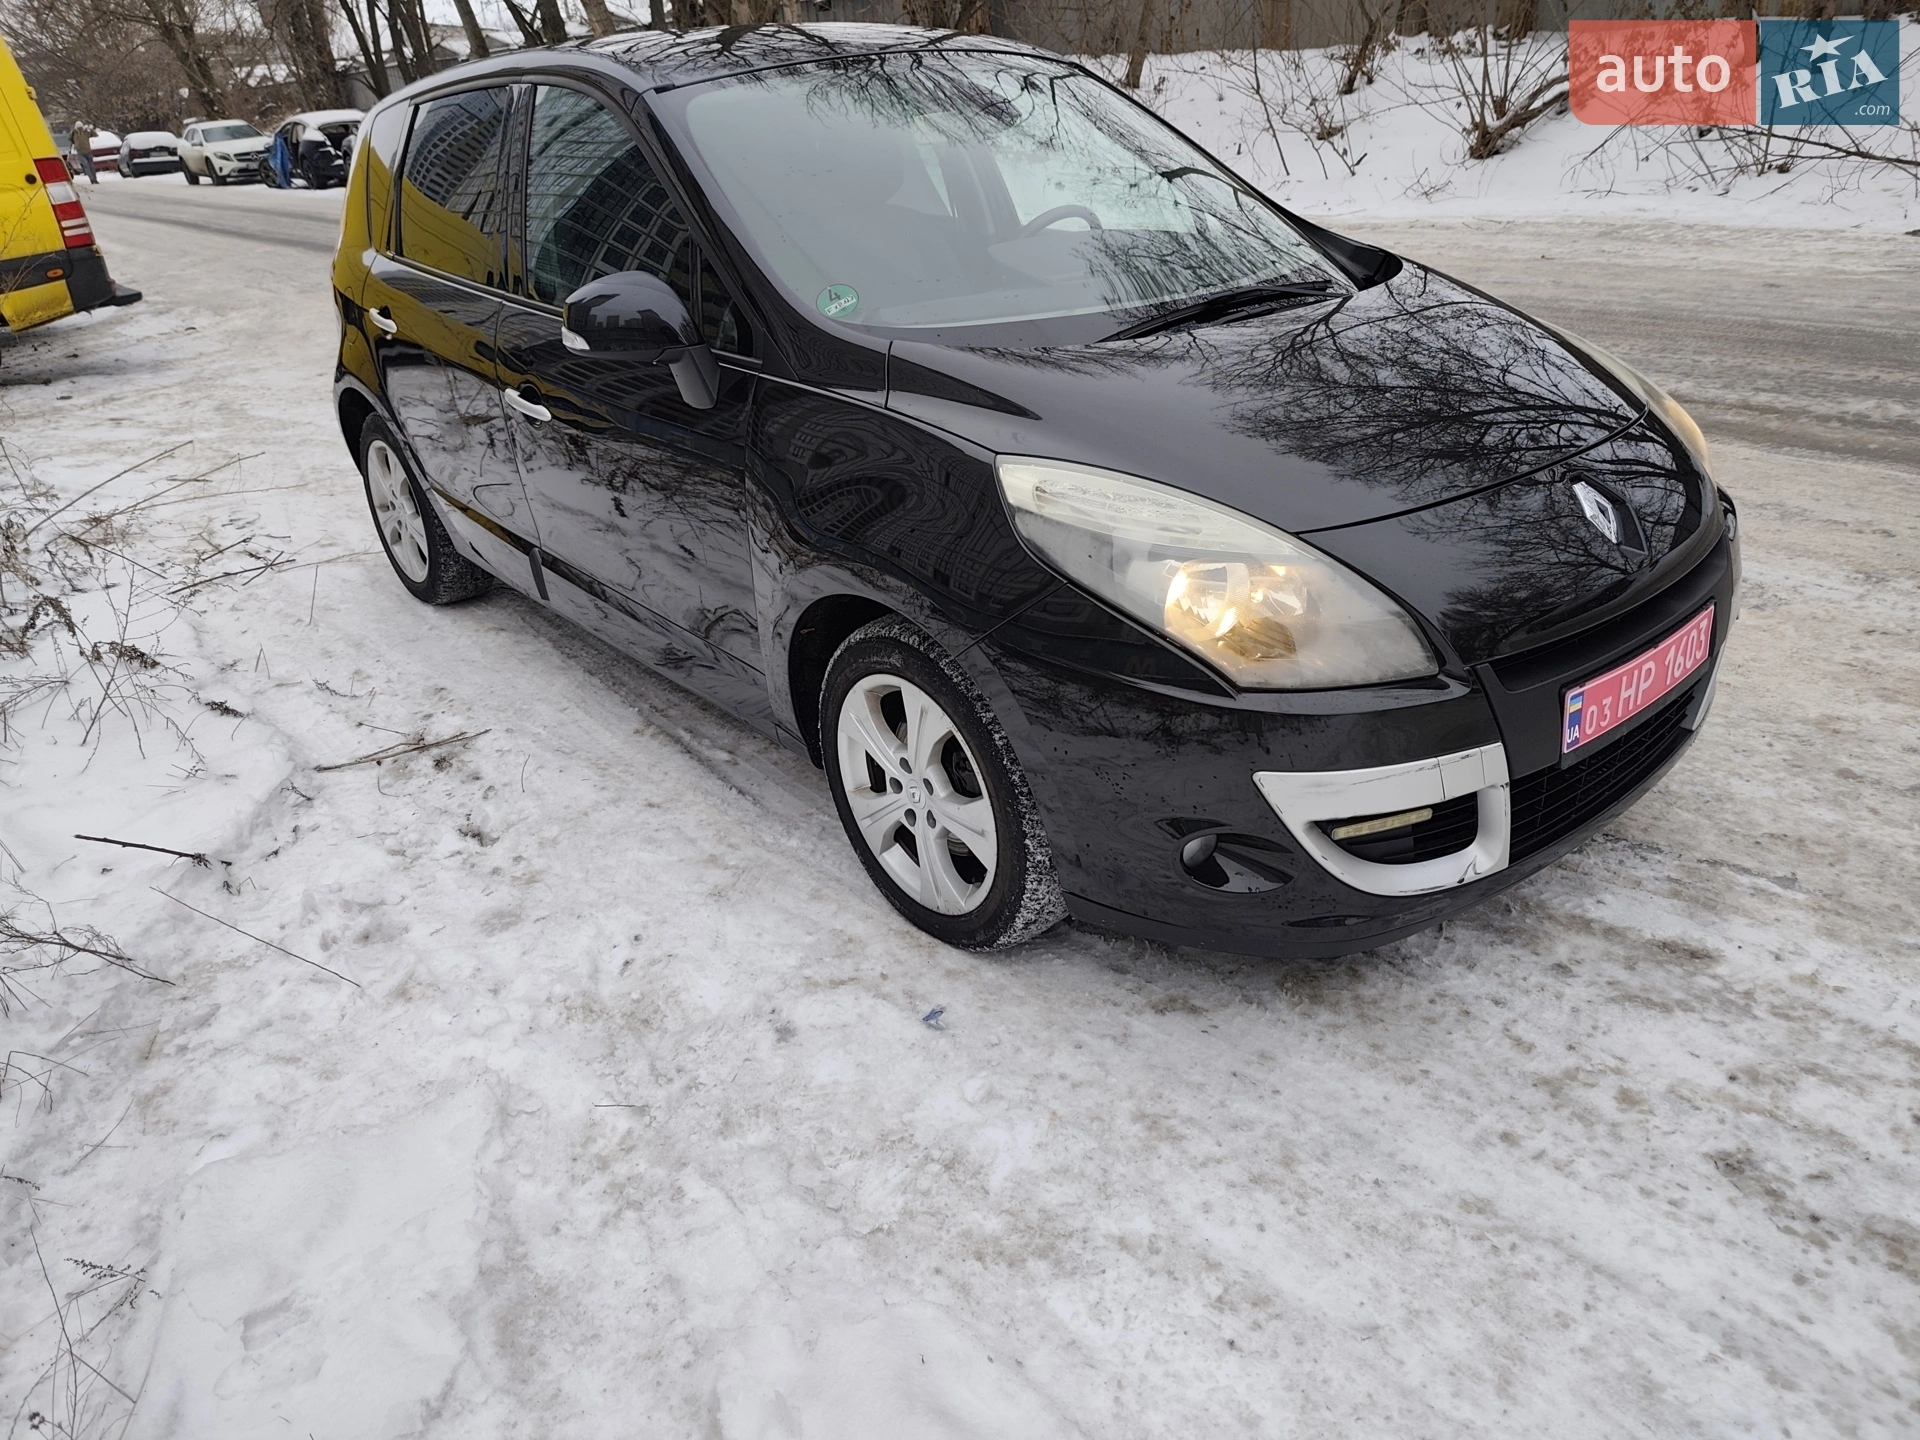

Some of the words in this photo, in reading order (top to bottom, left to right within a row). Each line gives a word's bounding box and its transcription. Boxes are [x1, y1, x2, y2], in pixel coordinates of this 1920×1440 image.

[828, 289, 841, 301] 4
[1584, 695, 1613, 736] 03
[1617, 660, 1656, 718] HP
[1664, 617, 1708, 686] 1603
[1566, 725, 1580, 743] UA
